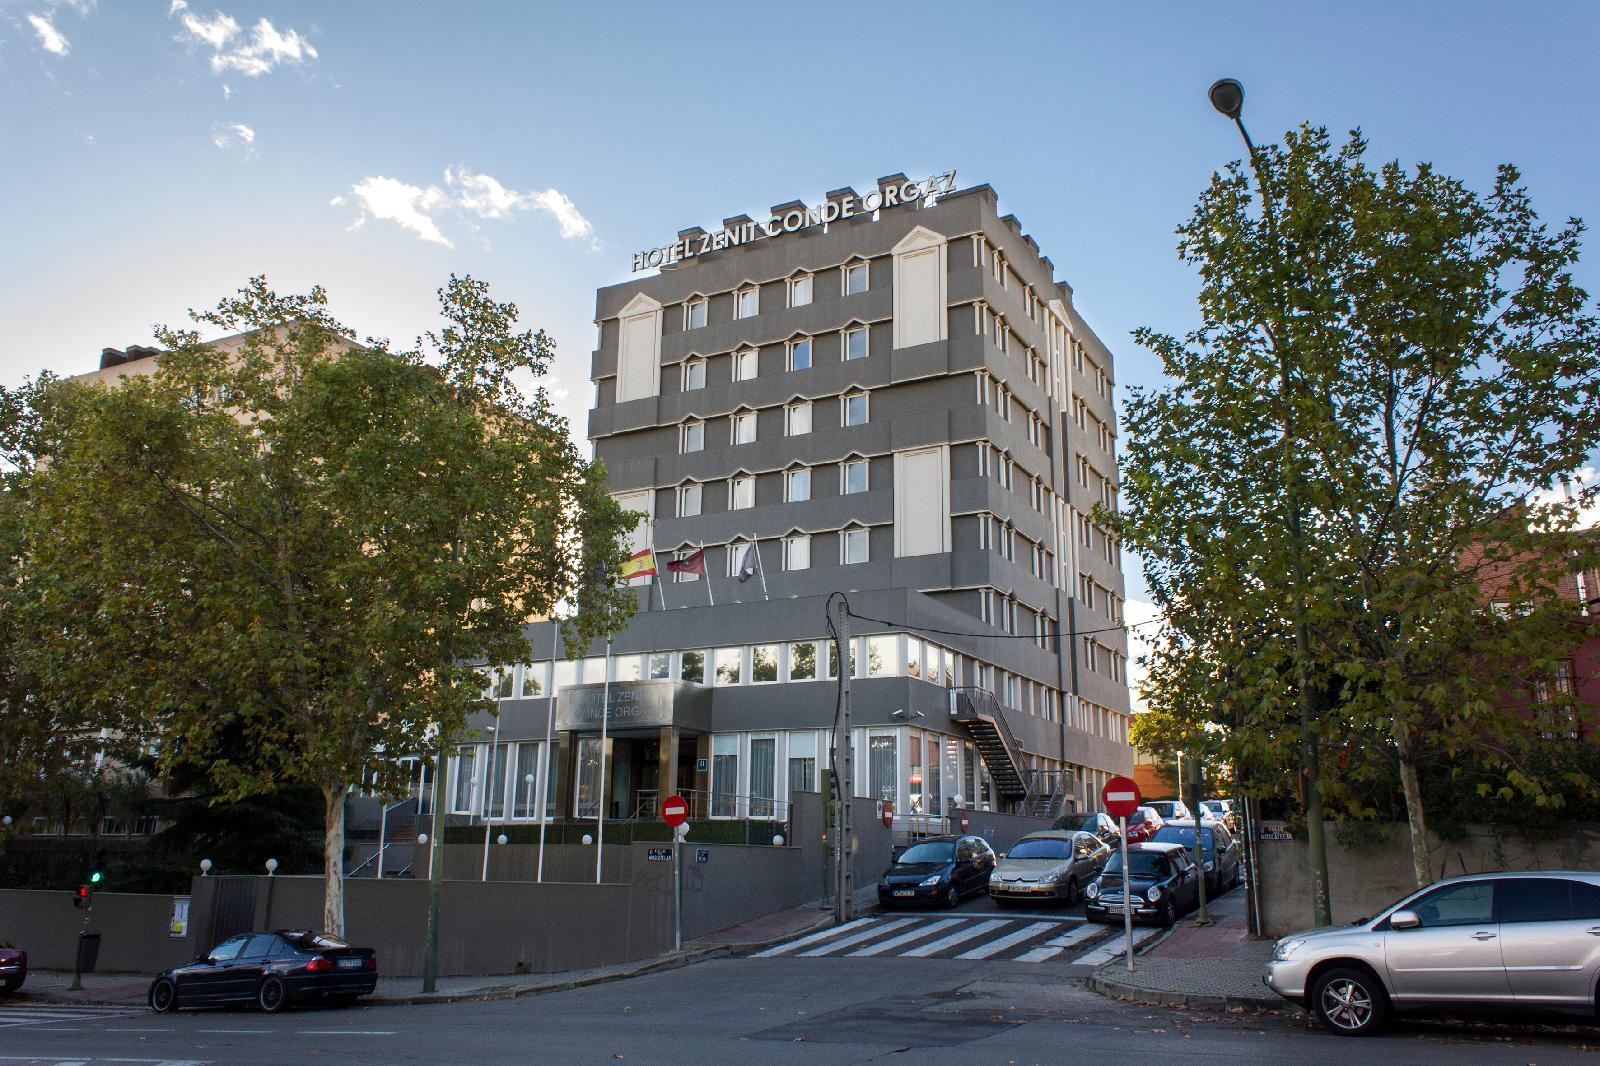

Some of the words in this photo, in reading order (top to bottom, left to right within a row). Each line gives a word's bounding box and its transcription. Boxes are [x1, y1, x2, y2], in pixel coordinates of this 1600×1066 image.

[631, 237, 694, 273] HOTEL
[696, 221, 760, 256] ZENIT
[764, 195, 855, 238] CONDE
[862, 169, 957, 213] ORGAZ
[617, 690, 648, 703] ZEN
[615, 704, 655, 718] ORGA
